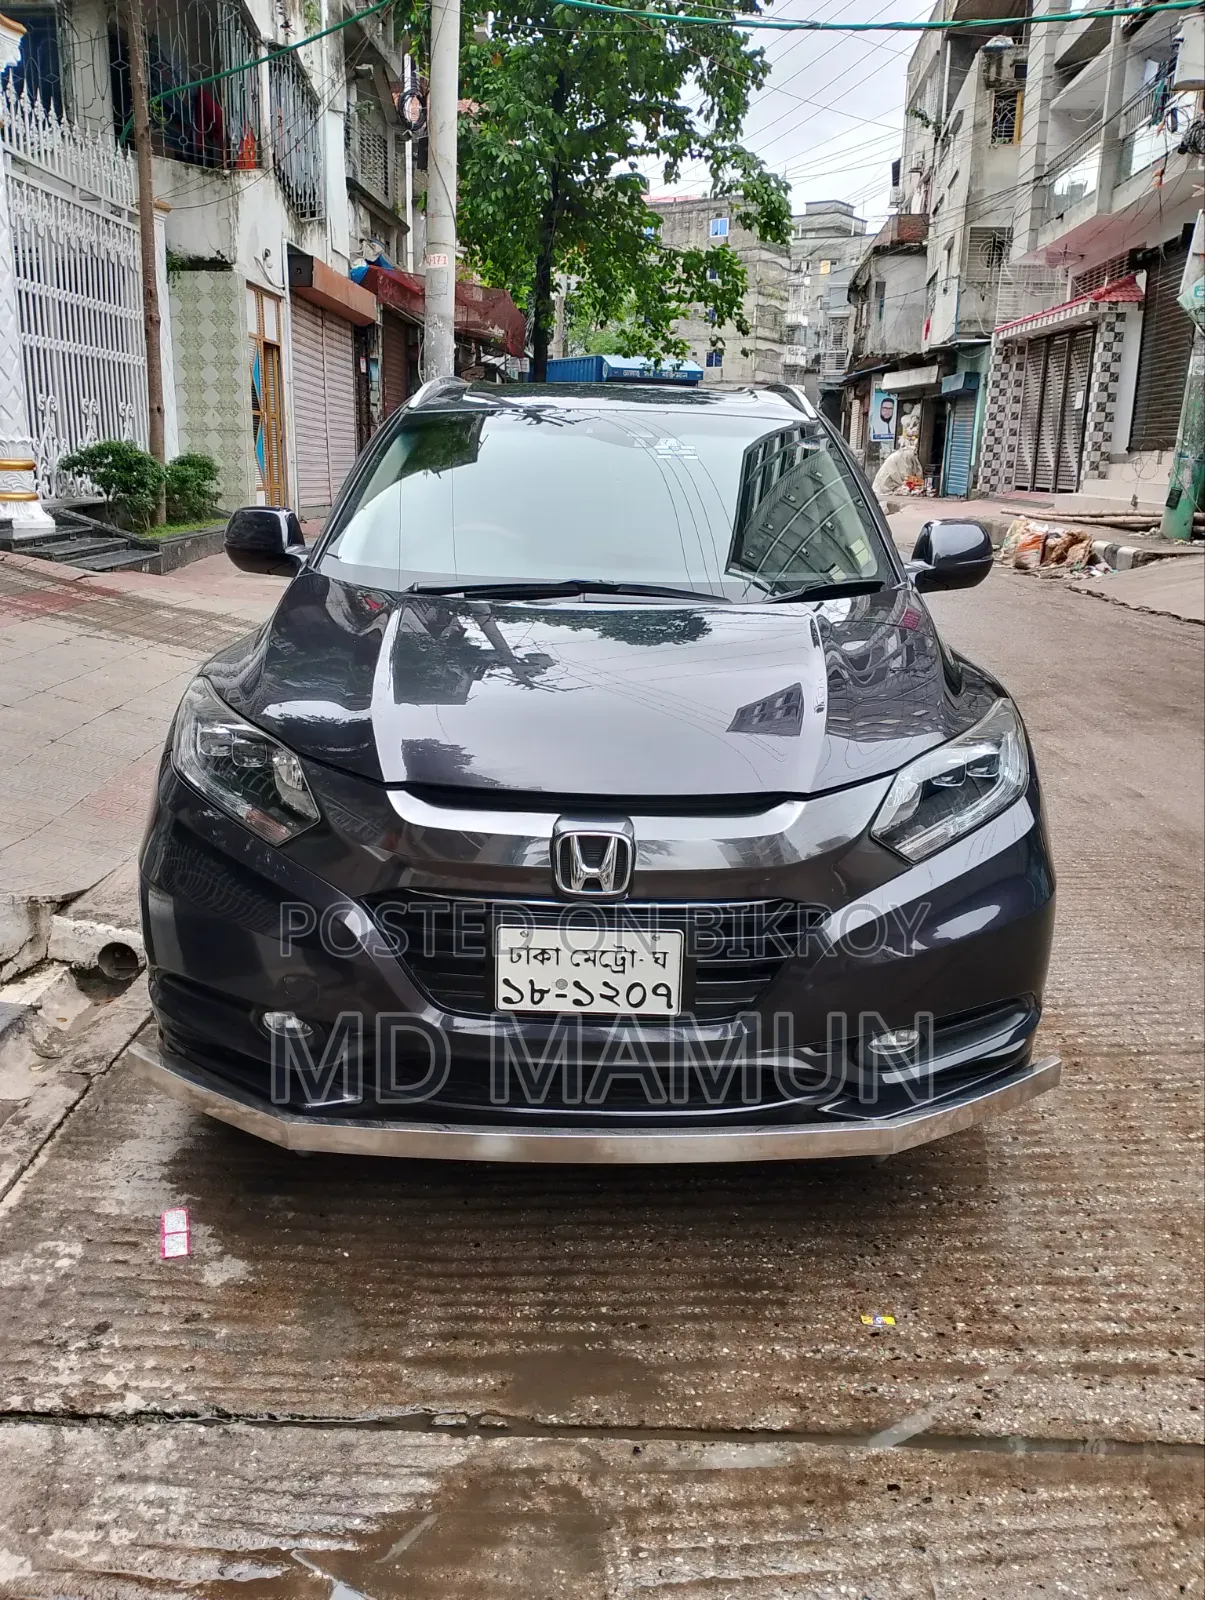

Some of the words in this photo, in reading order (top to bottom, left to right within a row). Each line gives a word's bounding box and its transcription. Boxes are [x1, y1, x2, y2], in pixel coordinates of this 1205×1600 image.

[508, 946, 561, 966] ঢাকা
[652, 951, 669, 969] ঘ
[501, 977, 674, 1010] ১৮-১২০৭
